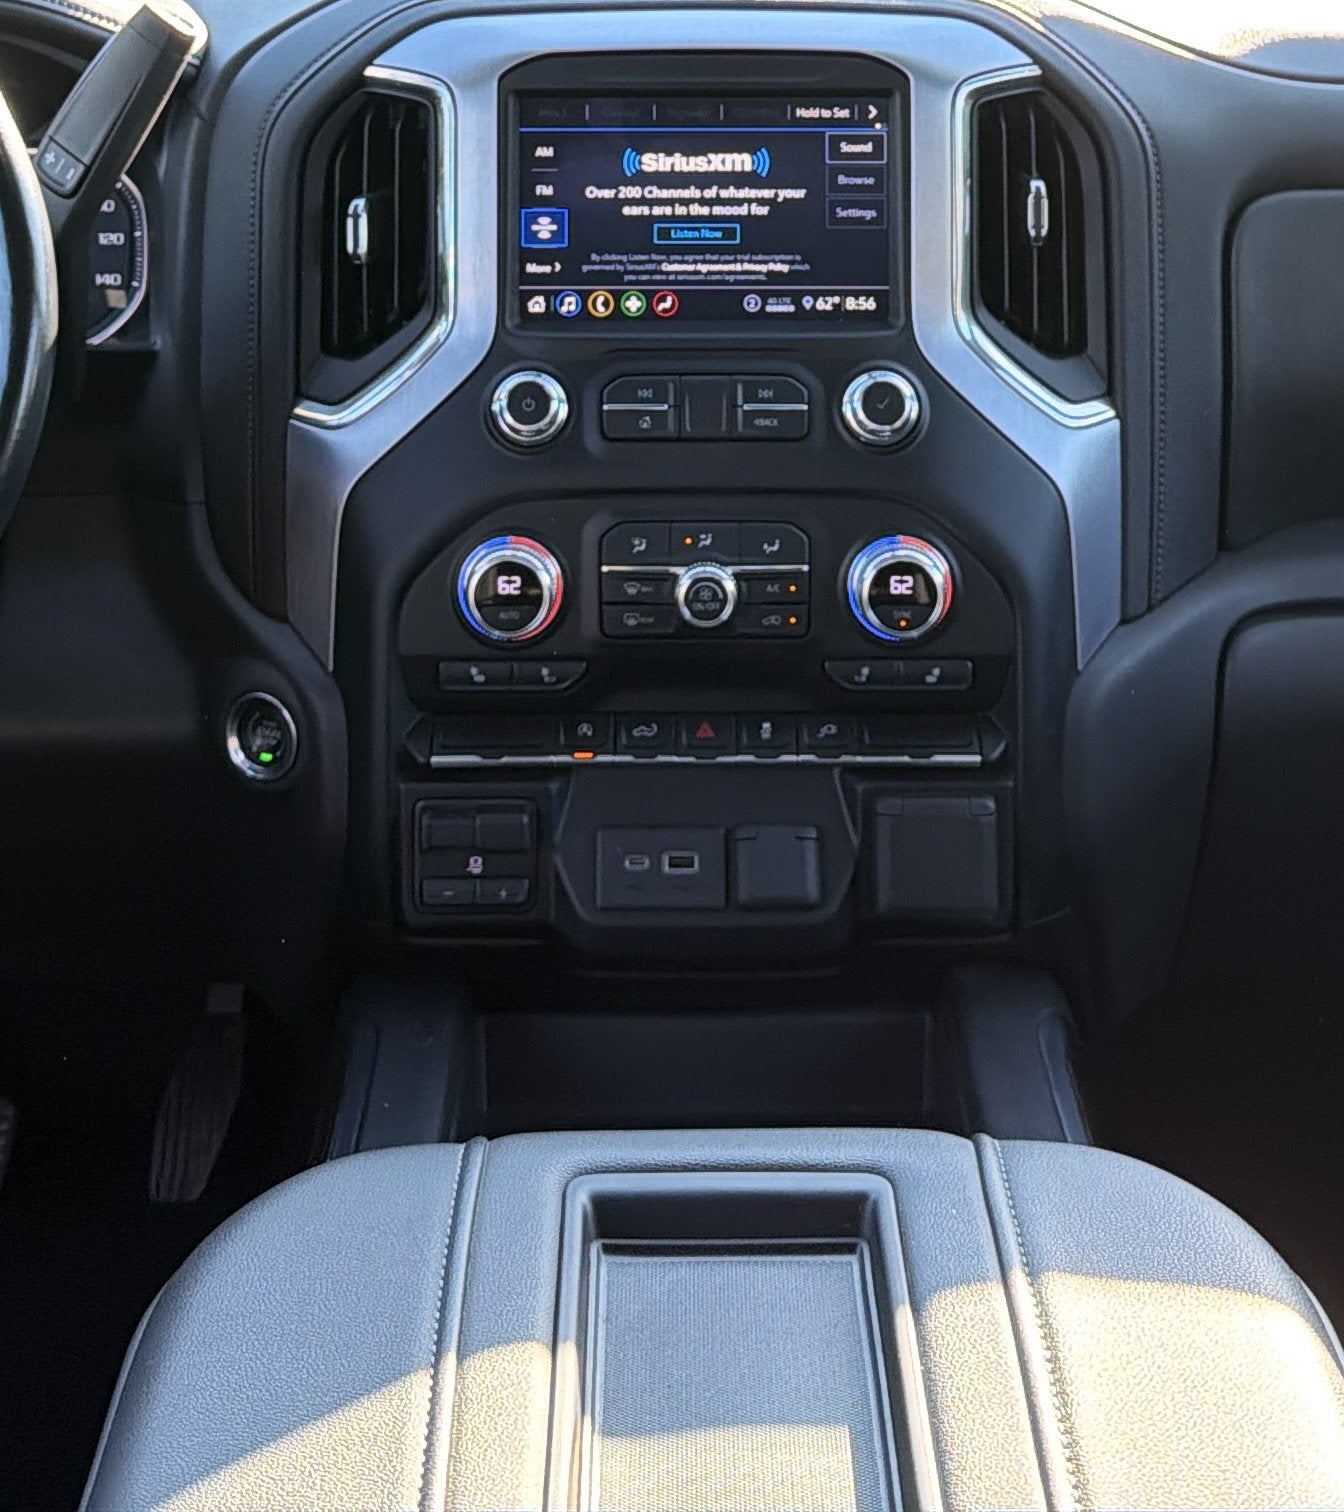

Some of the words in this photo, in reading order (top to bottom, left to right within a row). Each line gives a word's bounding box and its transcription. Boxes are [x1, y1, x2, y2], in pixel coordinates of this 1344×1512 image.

[795, 107, 820, 119] Hold
[821, 107, 832, 119] to
[833, 107, 850, 119] Set
[534, 146, 554, 157] AM
[840, 141, 873, 153] Sound
[837, 174, 875, 185] Browse
[535, 184, 554, 196] FM
[585, 186, 617, 199] Over
[618, 186, 642, 199] 200
[644, 186, 701, 199] Channels
[703, 185, 718, 198] of
[719, 186, 778, 199] whatever
[777, 189, 807, 202] your
[622, 206, 651, 216] ears
[652, 206, 673, 216] are
[674, 203, 688, 215] in
[689, 203, 710, 215] the
[711, 203, 748, 215] mood
[750, 203, 770, 215] for
[835, 207, 877, 220] Settings
[98, 233, 125, 246] 120
[671, 229, 699, 238] Listen
[701, 229, 723, 238] Now
[526, 263, 552, 273] More
[95, 273, 122, 286] 140
[845, 296, 877, 311] 8:56
[760, 418, 779, 427] BACK
[497, 575, 522, 595] 62
[889, 575, 914, 595] 62
